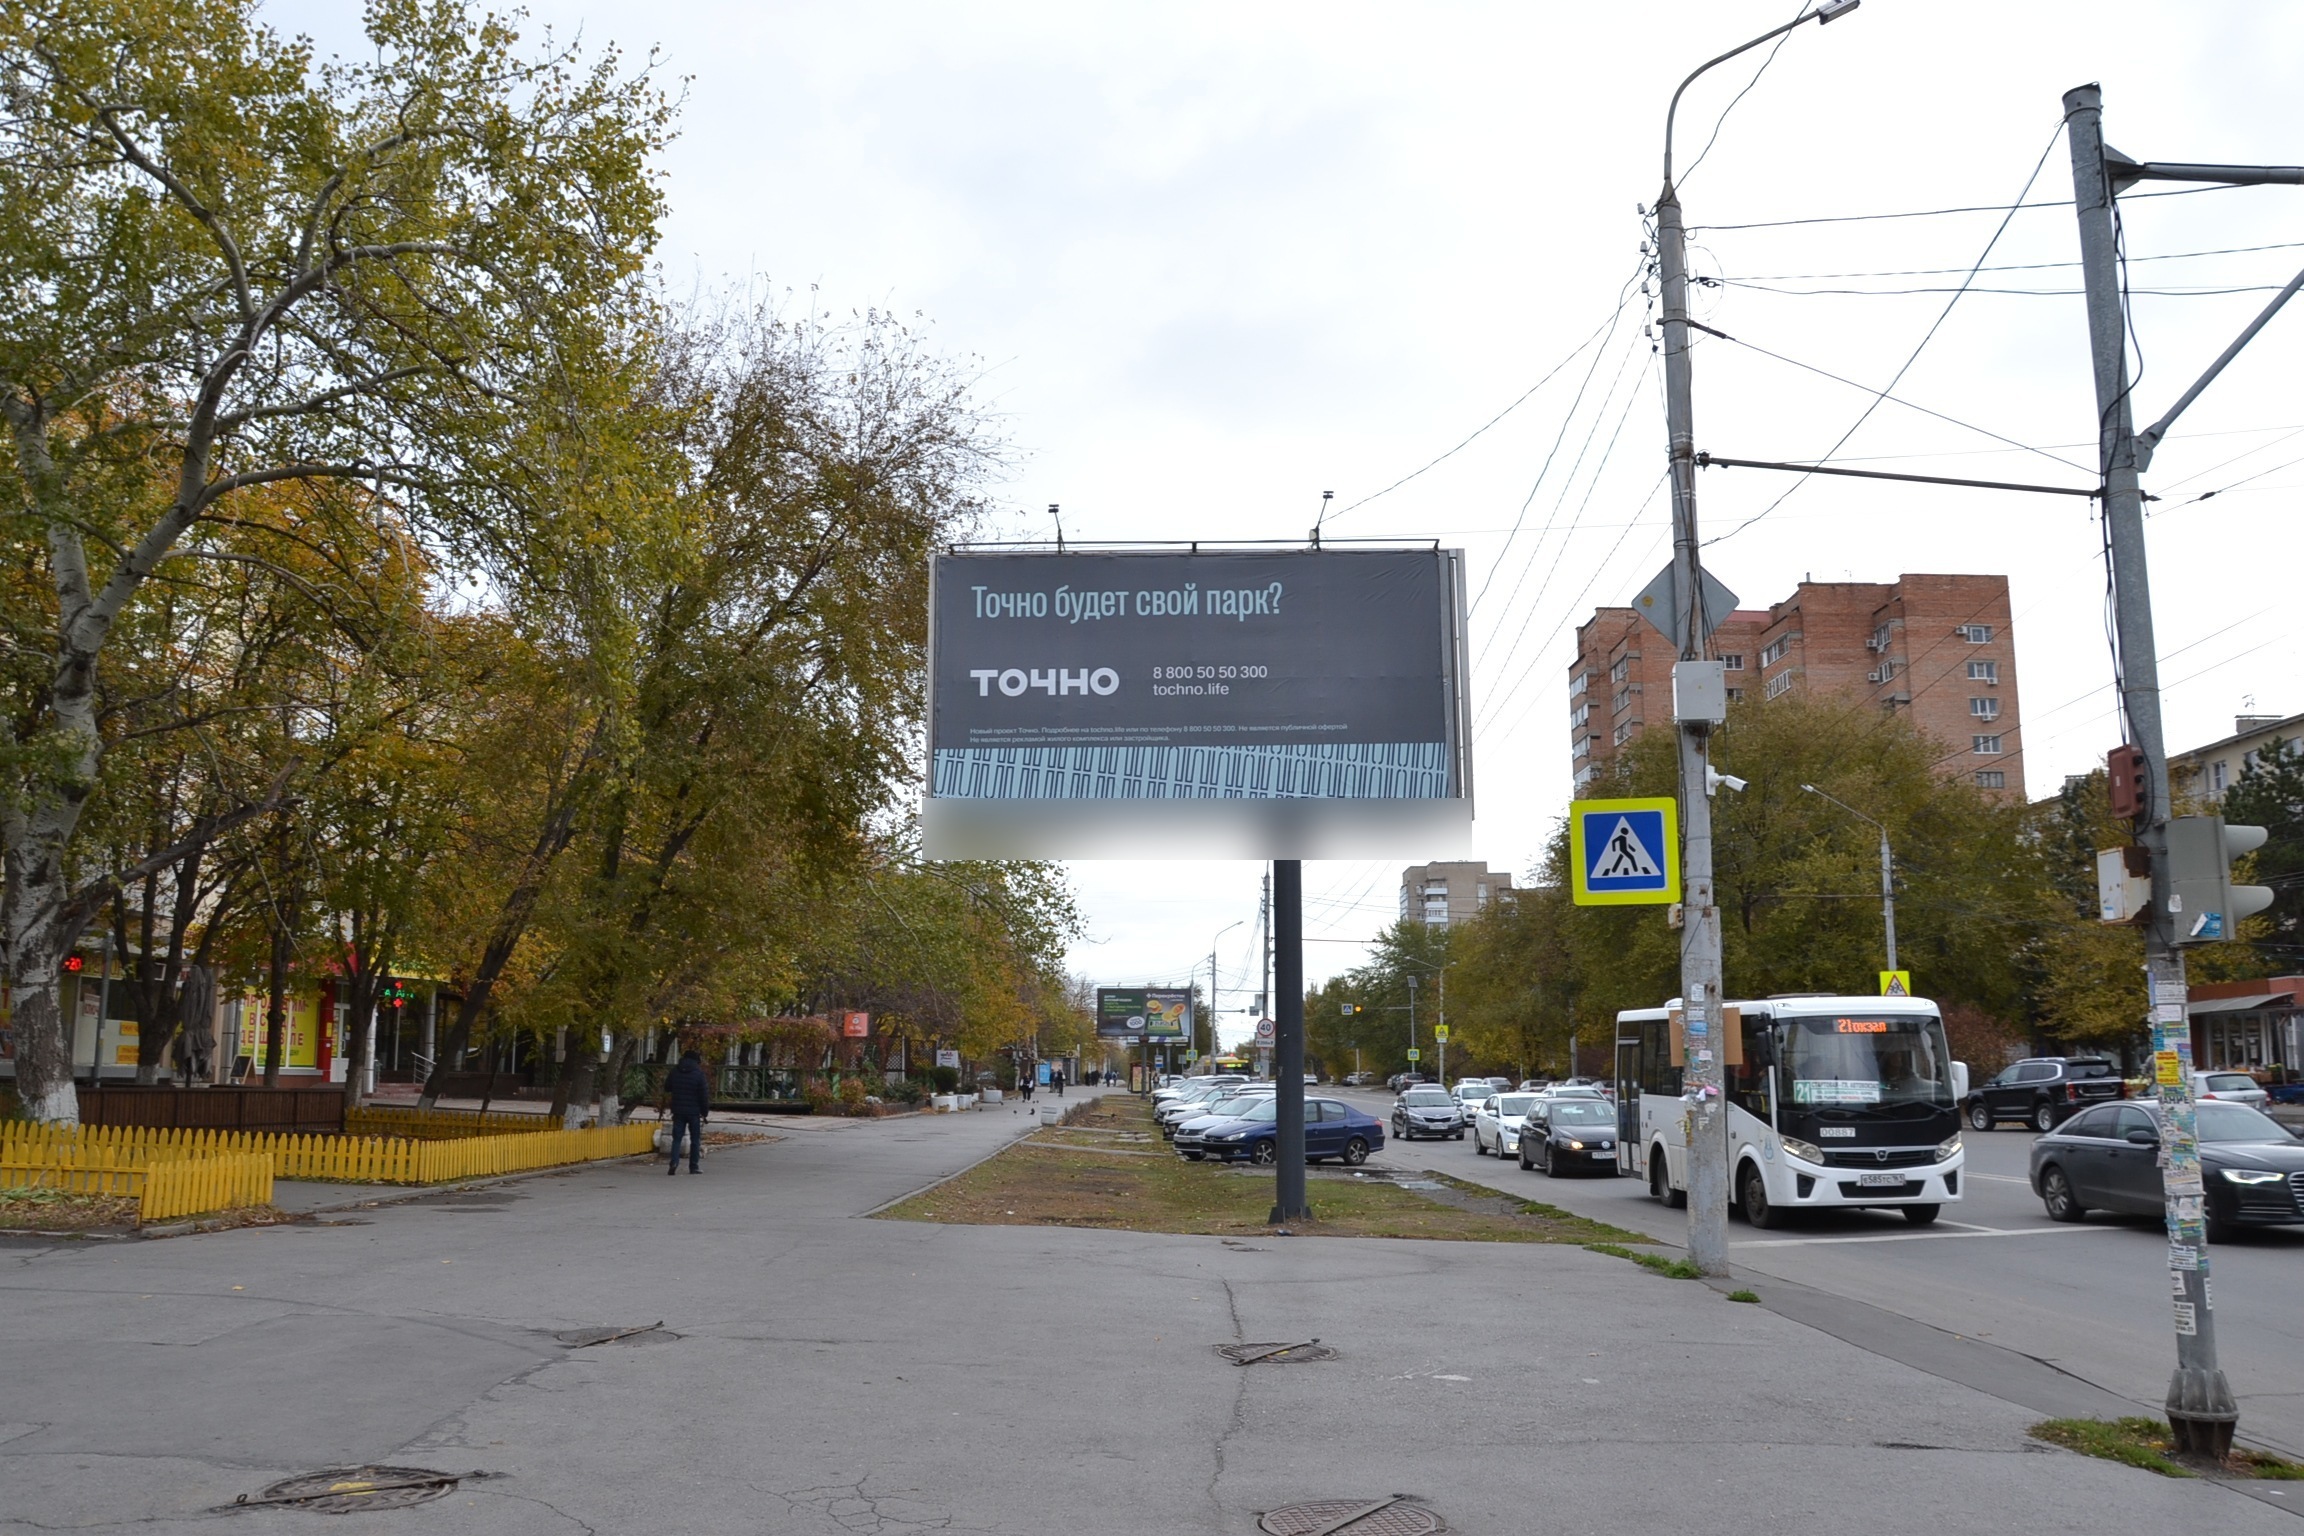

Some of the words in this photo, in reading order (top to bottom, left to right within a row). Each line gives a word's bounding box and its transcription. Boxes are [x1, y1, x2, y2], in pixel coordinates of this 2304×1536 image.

[971, 586, 1047, 618] Точно
[1055, 585, 1129, 624] будет
[1136, 583, 1198, 616] свой
[1206, 582, 1283, 622] парк?
[1152, 667, 1162, 679] 8
[1165, 667, 1193, 679] 800
[1196, 666, 1216, 679] 50
[1218, 666, 1237, 679] 50
[1240, 665, 1268, 678] 300
[1152, 683, 1230, 696] tochno.life
[1041, 727, 1080, 735] Подробнее
[1317, 723, 1348, 732] офертой
[1012, 736, 1046, 744] рекламой
[1260, 1023, 1271, 1032] 40
[1796, 1082, 1811, 1103] 21
[1821, 1128, 1855, 1137] 00887
